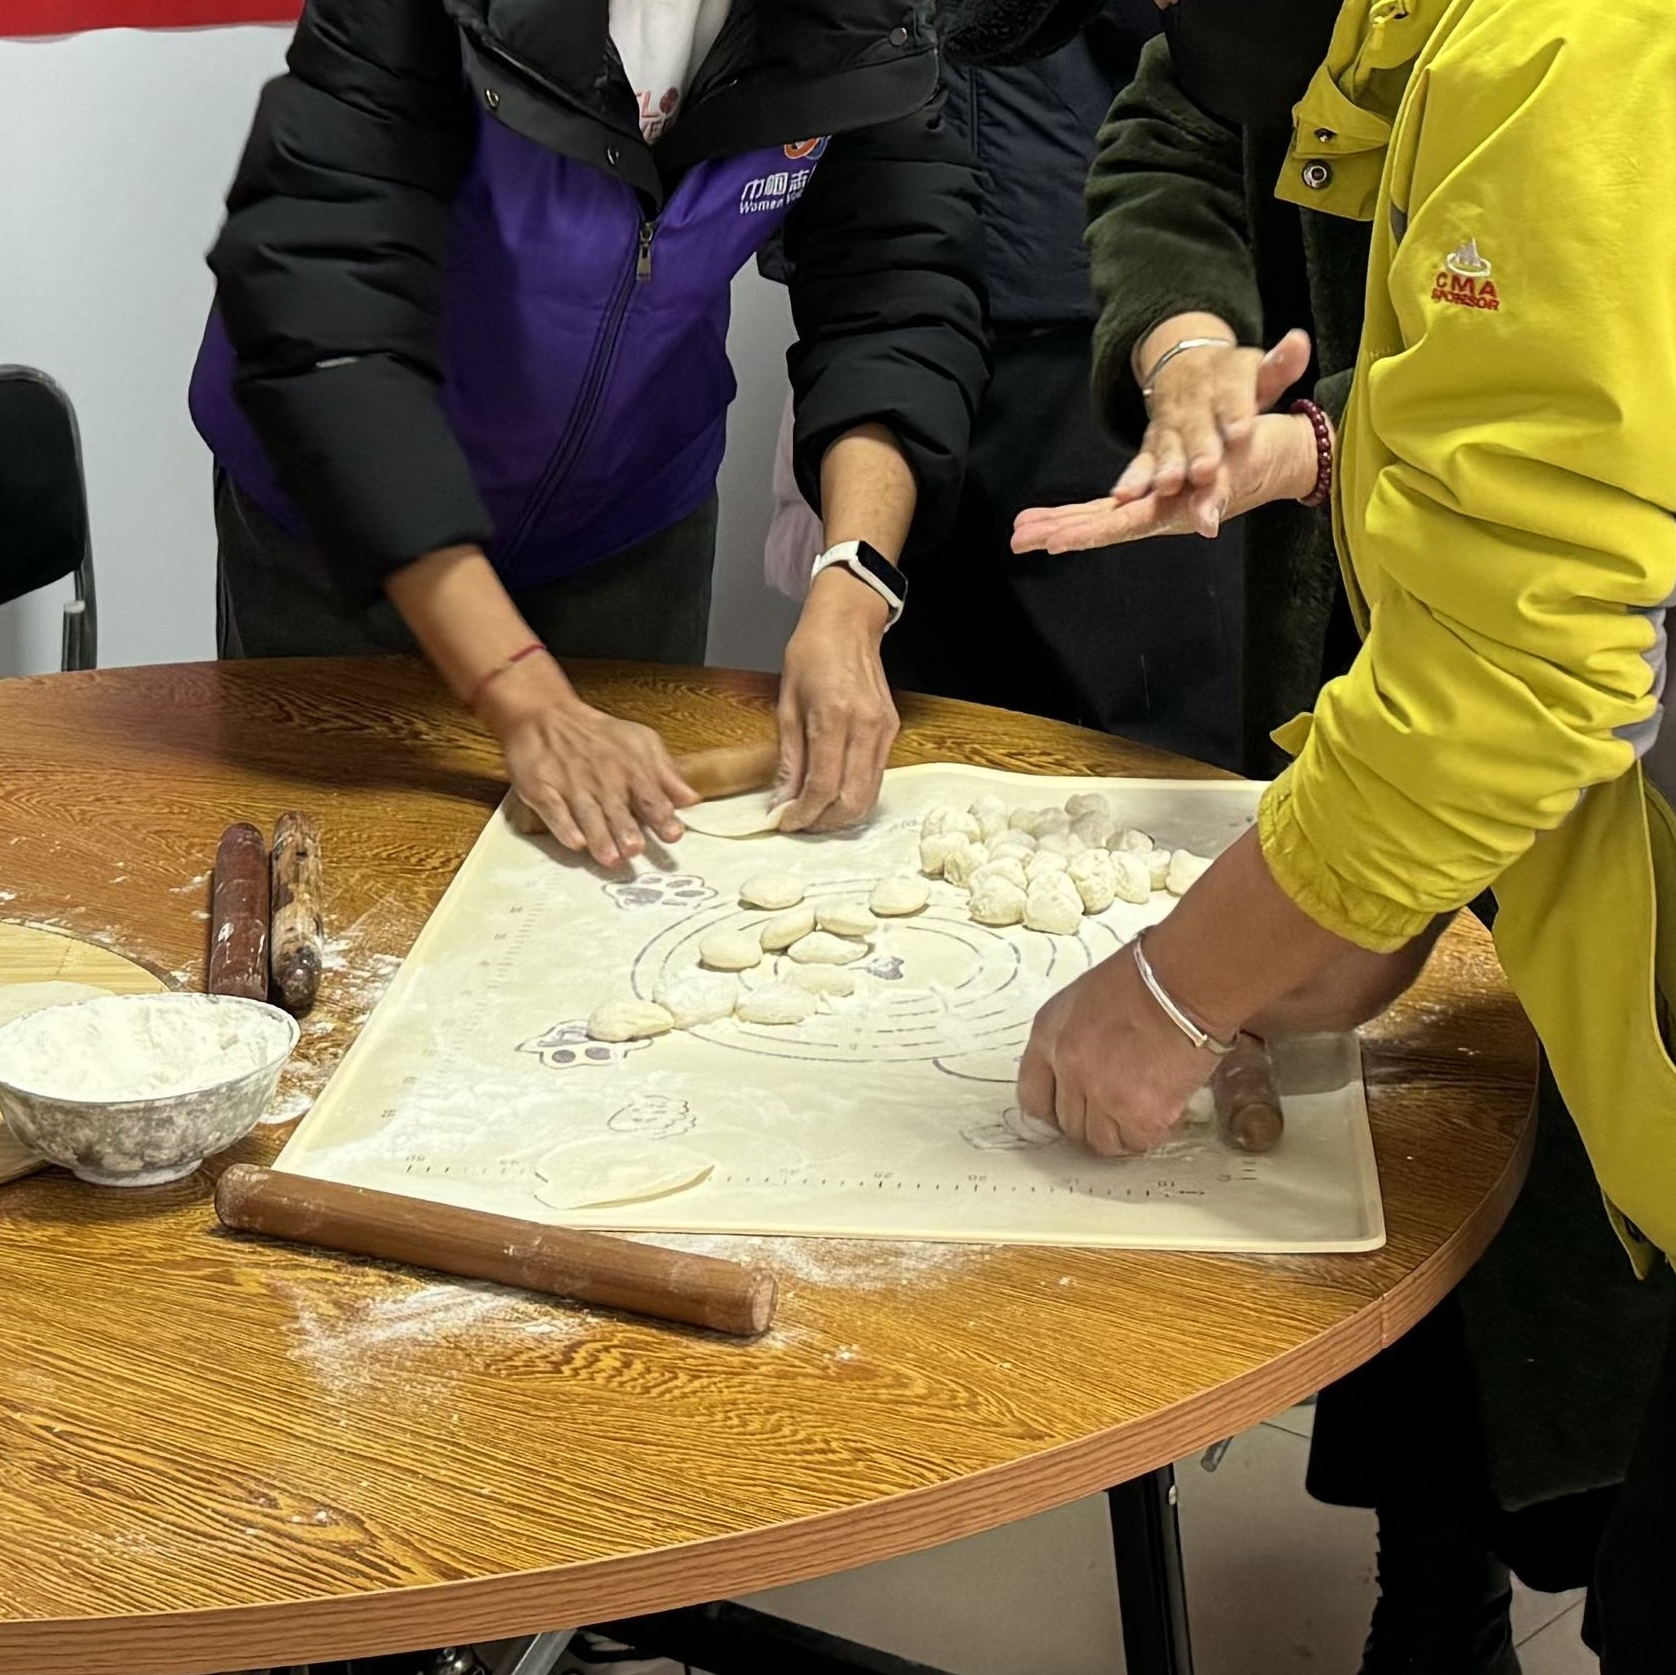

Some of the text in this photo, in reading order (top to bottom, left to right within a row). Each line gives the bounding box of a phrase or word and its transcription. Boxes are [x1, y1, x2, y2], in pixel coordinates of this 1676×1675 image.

[740, 162, 818, 201] 巾帼志
[1435, 271, 1497, 299] CMA
